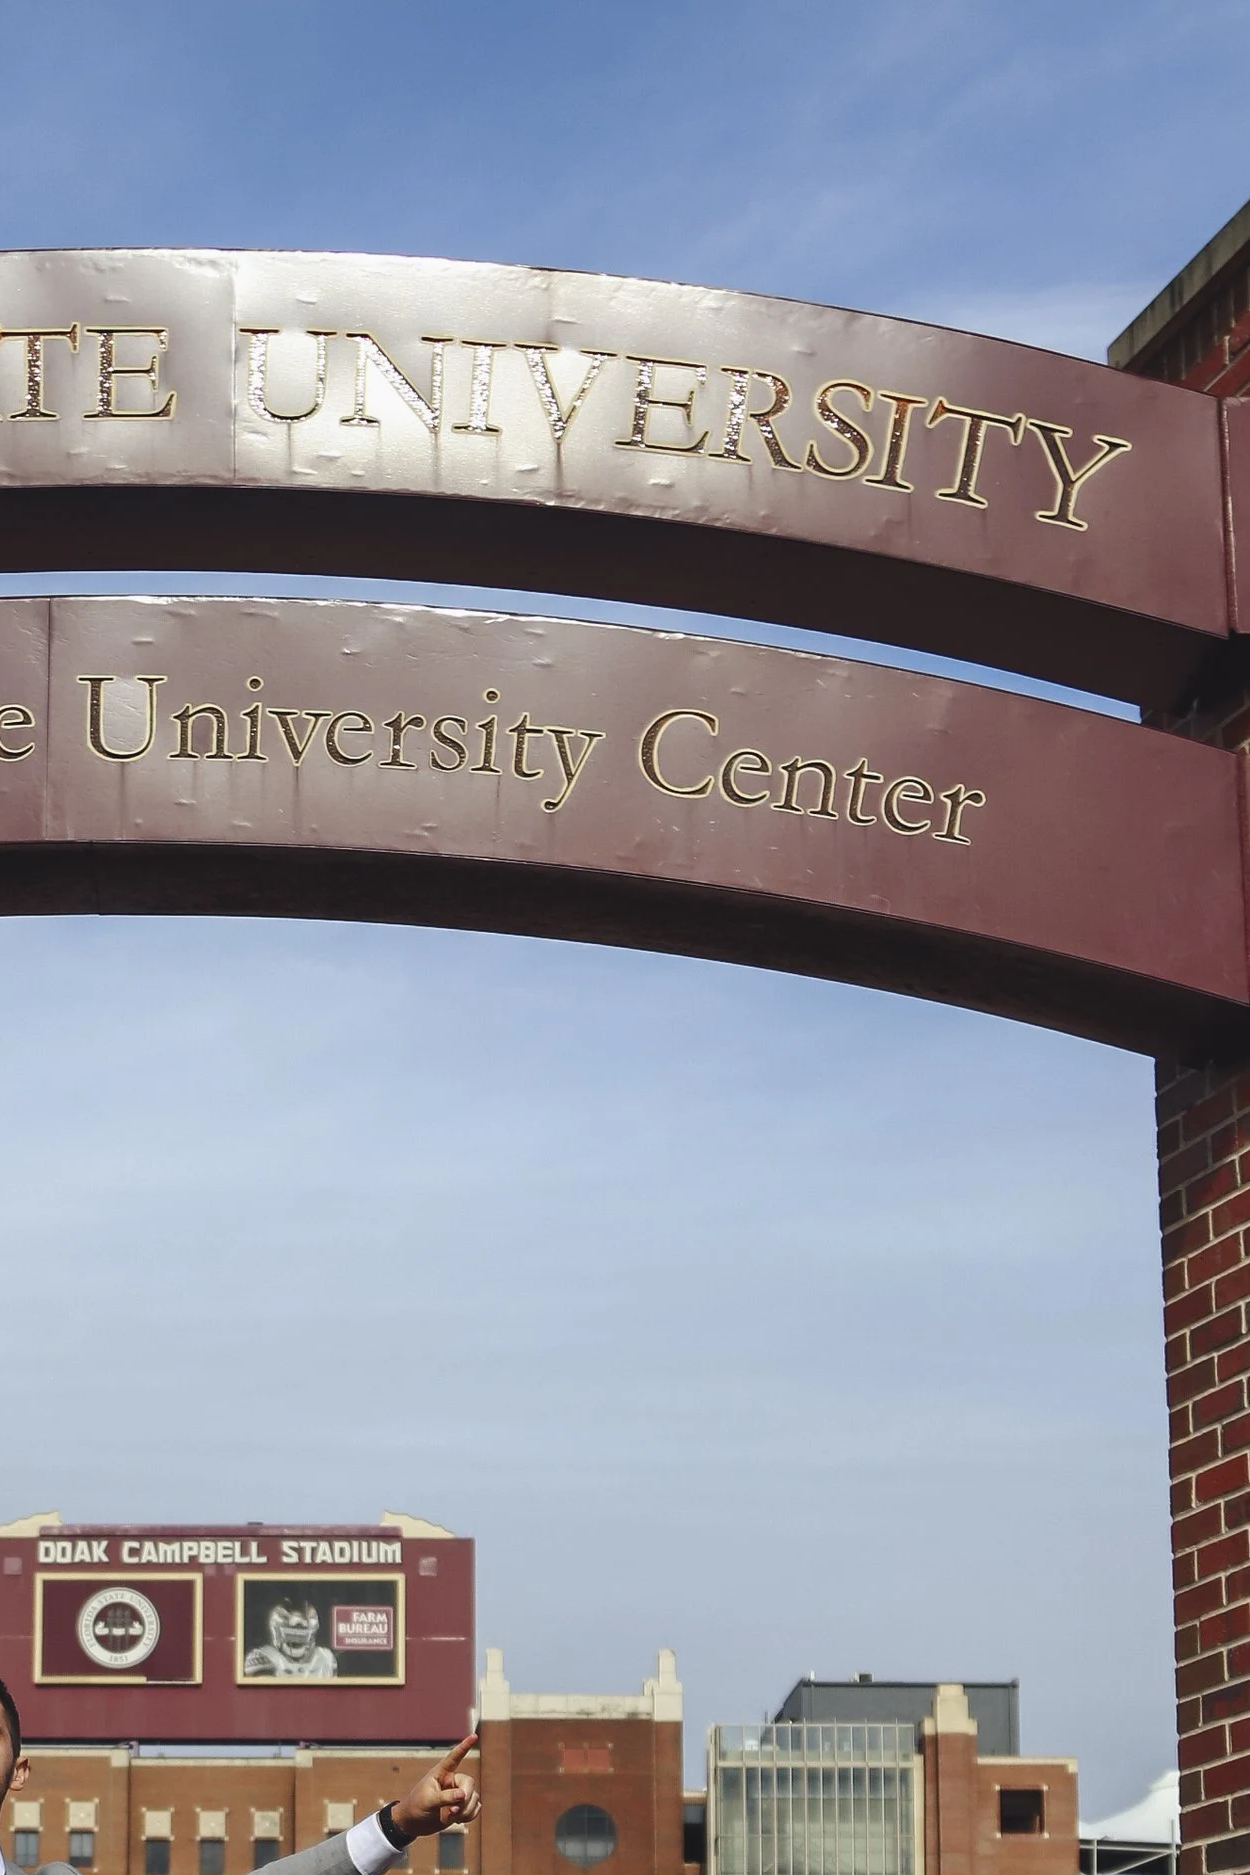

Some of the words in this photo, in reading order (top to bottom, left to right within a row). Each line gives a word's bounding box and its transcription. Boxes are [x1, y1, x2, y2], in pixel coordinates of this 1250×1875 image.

[237, 326, 1134, 533] UNIVERSITY
[76, 674, 606, 814] University
[637, 708, 986, 846] Center
[39, 1541, 109, 1564] DOAK
[122, 1541, 267, 1564] CAMPBELL
[282, 1541, 402, 1564] STADIUM
[84, 1605, 97, 1648] FLORIDA
[98, 1592, 125, 1605] STATE
[338, 1623, 388, 1634] BUREAU
[353, 1611, 388, 1623] FARM
[345, 1637, 388, 1645] INSURANCE
